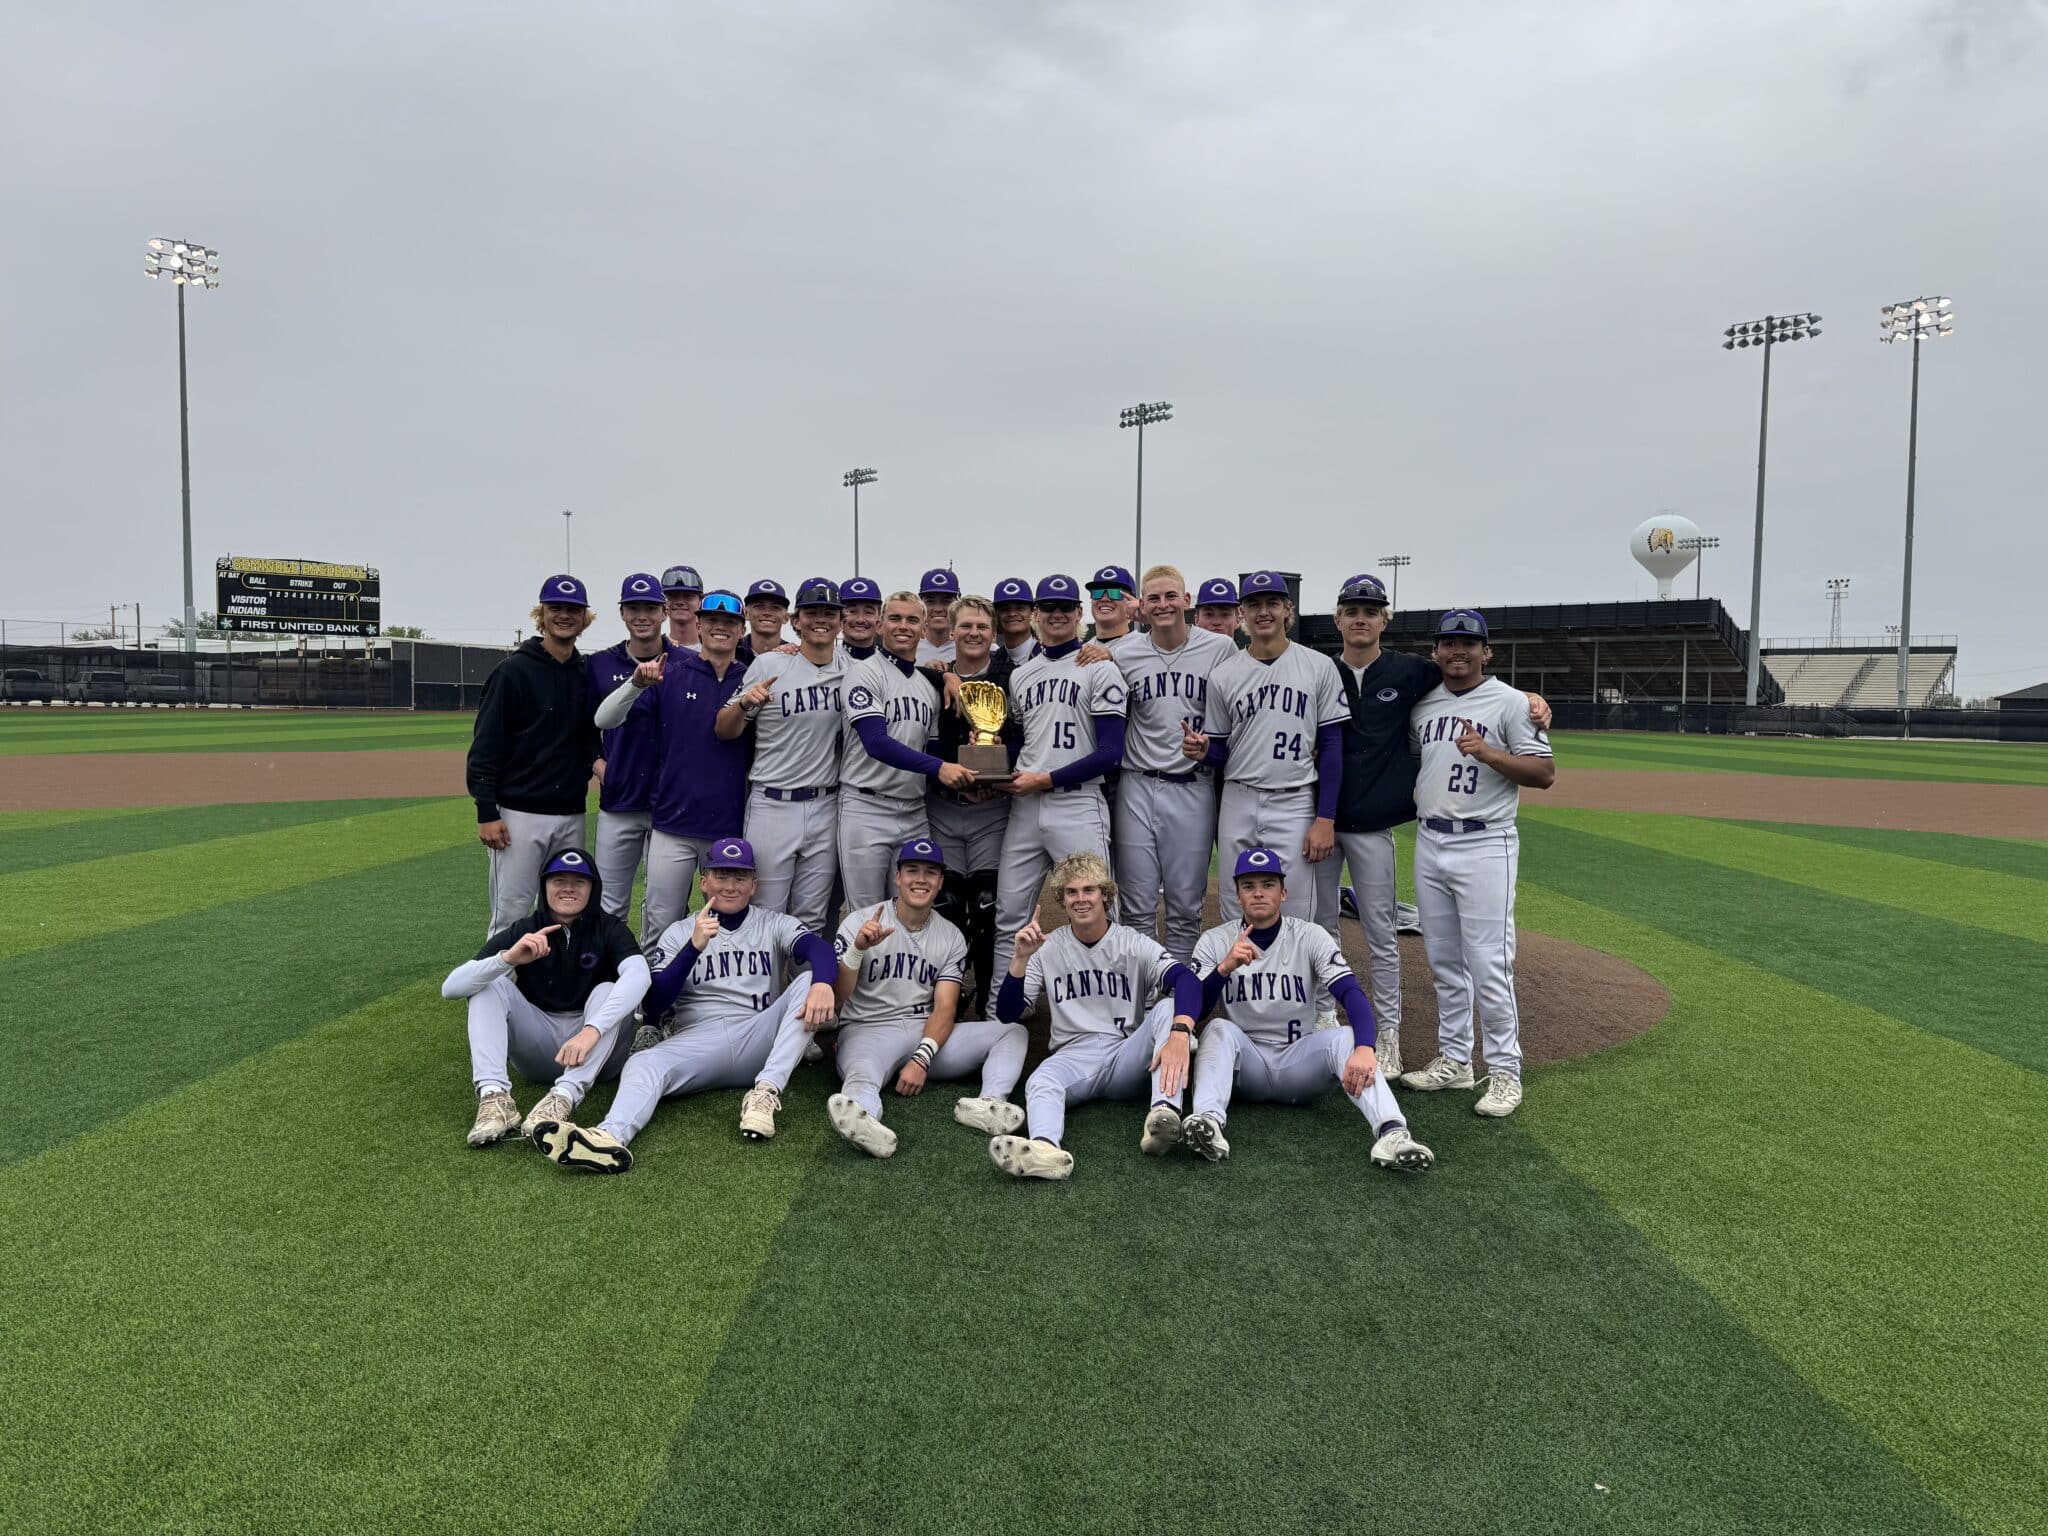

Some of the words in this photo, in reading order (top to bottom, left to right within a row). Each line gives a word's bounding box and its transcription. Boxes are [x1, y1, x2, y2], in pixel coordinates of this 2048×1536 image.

[249, 576, 266, 585] BALL
[289, 579, 314, 588] STRIKE
[227, 605, 267, 615] INDIANS
[231, 595, 267, 605] VISITOR
[240, 620, 277, 630] FIRST
[279, 621, 324, 632] UNITED
[327, 623, 360, 633] BANK
[781, 686, 842, 717] CANYO
[1053, 721, 1076, 750] 15
[1273, 732, 1301, 761] 24
[1448, 763, 1479, 795] 23
[692, 950, 772, 986] CANYON
[868, 952, 938, 987] CANYON
[1054, 969, 1132, 1004] CANYON
[1225, 972, 1307, 1004] CANYON
[1113, 1016, 1128, 1039] 7
[1287, 1019, 1301, 1045] 6
